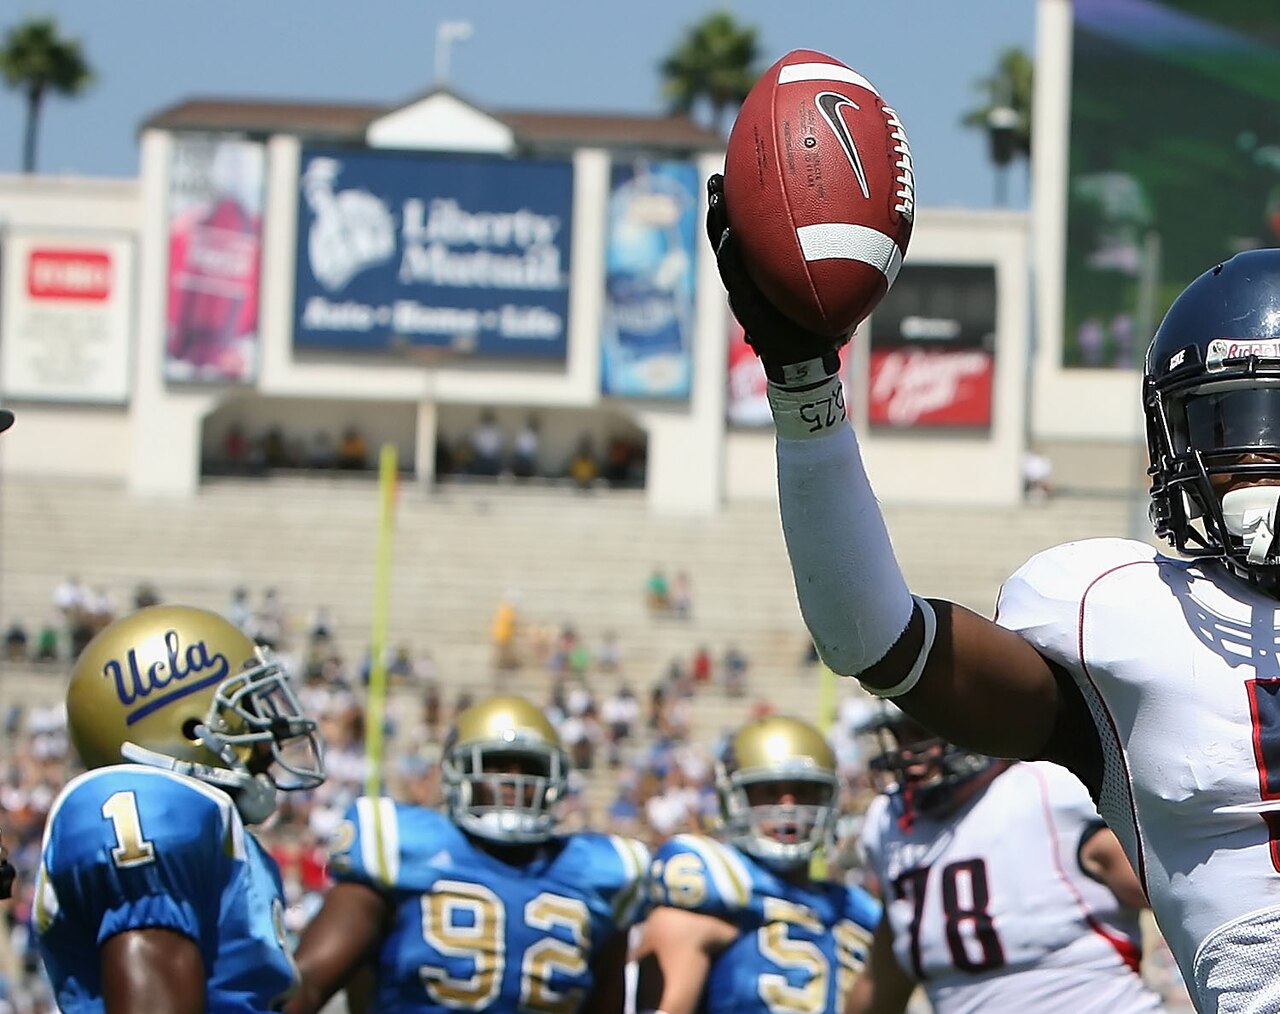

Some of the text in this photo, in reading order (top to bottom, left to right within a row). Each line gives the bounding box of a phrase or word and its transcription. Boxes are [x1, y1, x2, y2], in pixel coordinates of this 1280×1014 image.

[403, 198, 559, 252] Liberty
[104, 631, 228, 722] Ucla
[102, 791, 155, 868] 1
[892, 857, 1006, 981] 78
